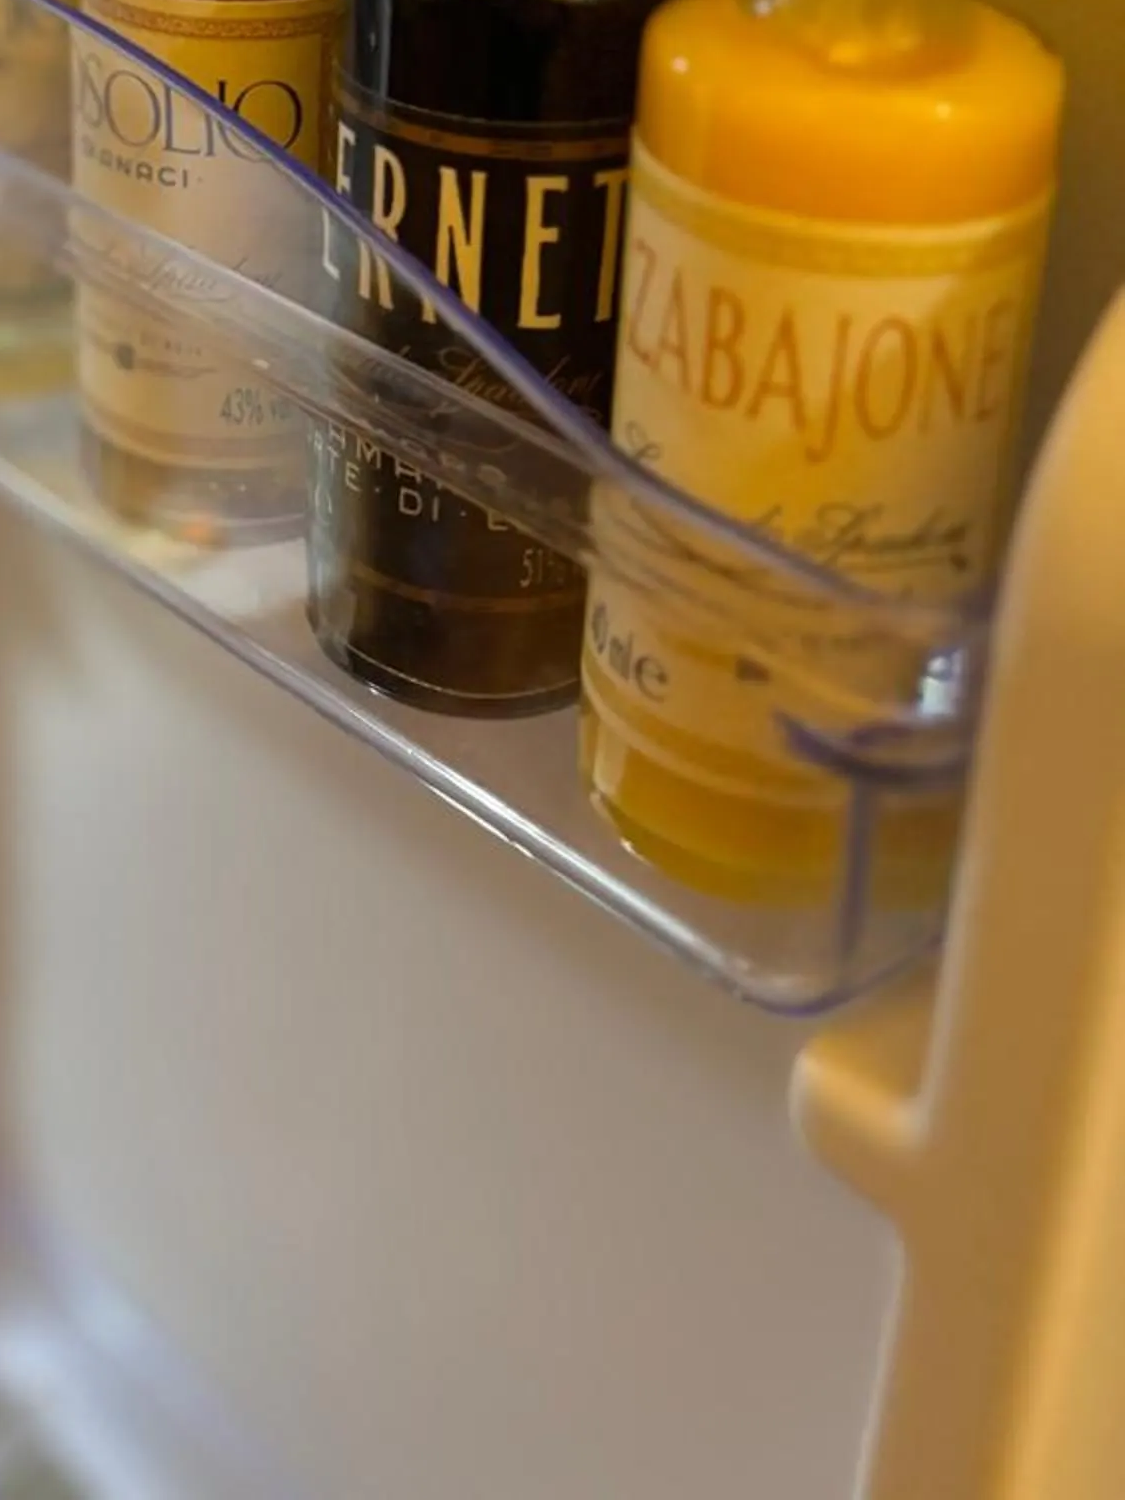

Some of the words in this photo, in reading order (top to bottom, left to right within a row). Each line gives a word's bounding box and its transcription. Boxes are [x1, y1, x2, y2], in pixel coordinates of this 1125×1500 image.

[321, 120, 633, 330] ERNET
[627, 240, 1012, 464] ZABAJONE
[398, 487, 440, 523] DI
